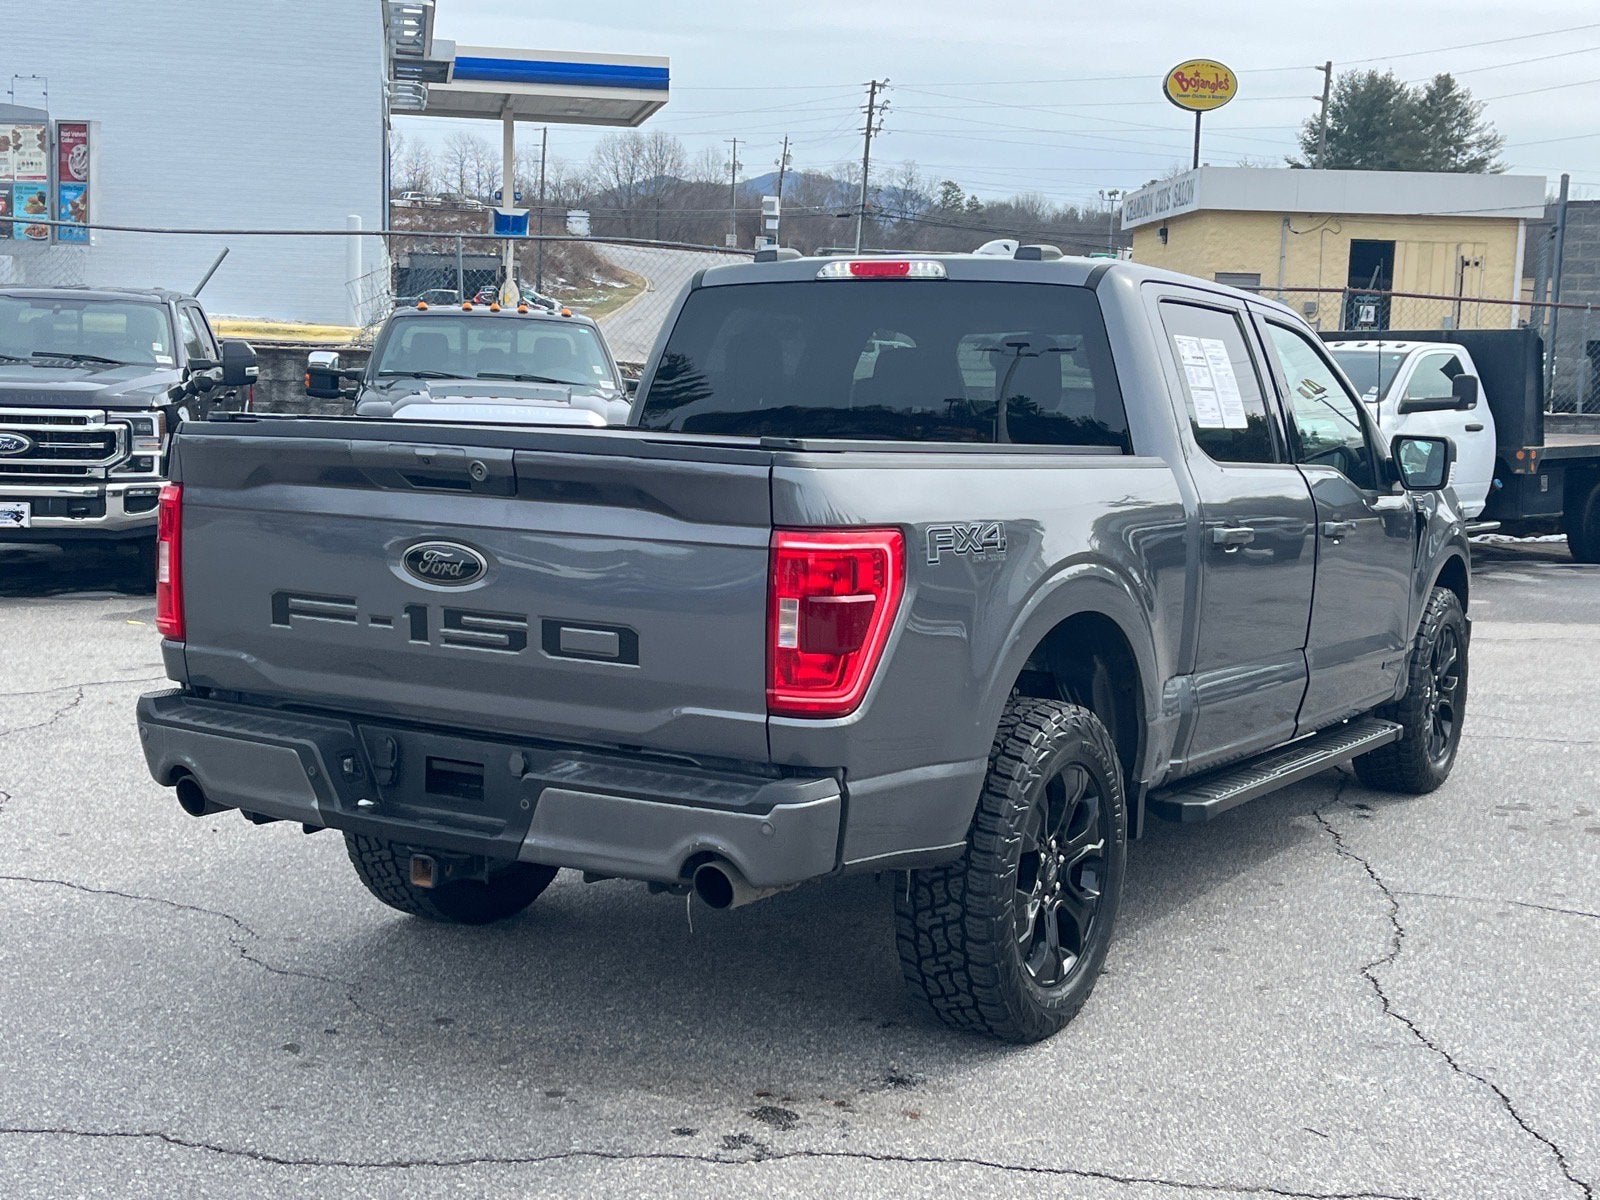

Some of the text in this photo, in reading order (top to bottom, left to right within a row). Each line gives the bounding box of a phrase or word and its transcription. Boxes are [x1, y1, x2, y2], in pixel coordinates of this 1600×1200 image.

[418, 549, 465, 578] Ford
[925, 521, 1008, 566] FX4
[270, 589, 641, 668] F-150
